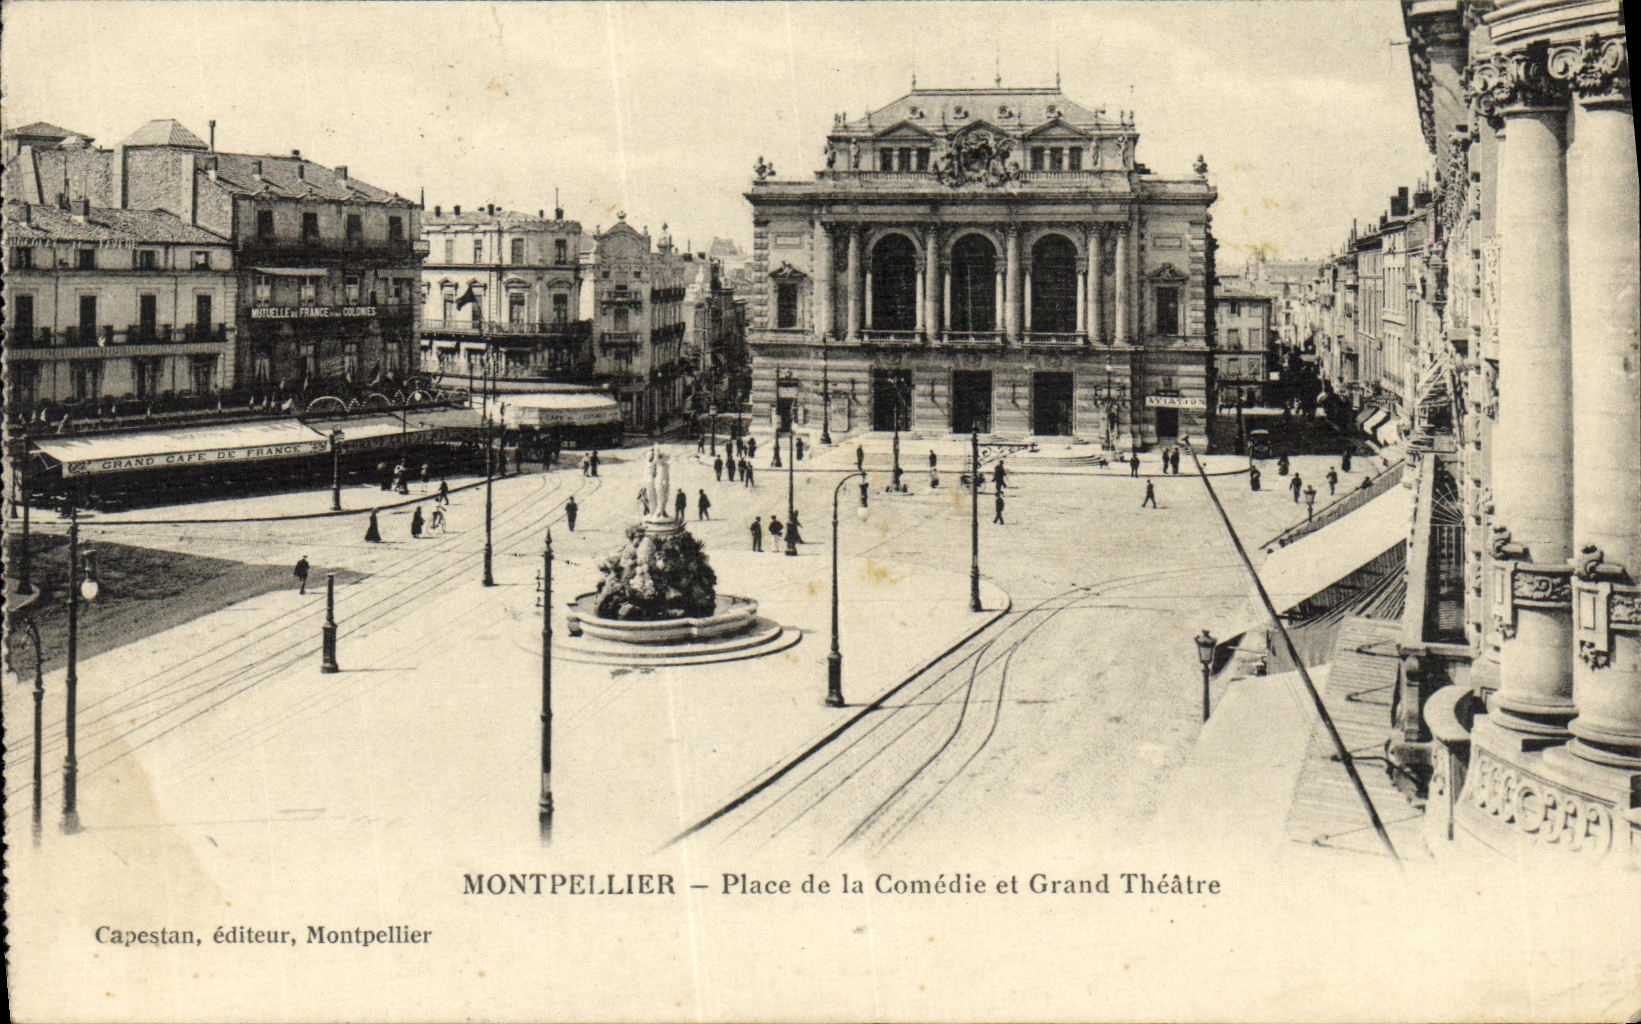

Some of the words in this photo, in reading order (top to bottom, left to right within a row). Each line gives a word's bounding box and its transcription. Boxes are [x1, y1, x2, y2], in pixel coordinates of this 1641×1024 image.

[251, 307, 290, 318] MUTUELLE
[300, 307, 329, 317] FRANCE
[343, 306, 377, 316] COLONIES
[1148, 397, 1206, 406] AVIATION
[102, 457, 155, 470] GRAND
[217, 450, 236, 460] DE
[247, 444, 303, 457] FRANCE
